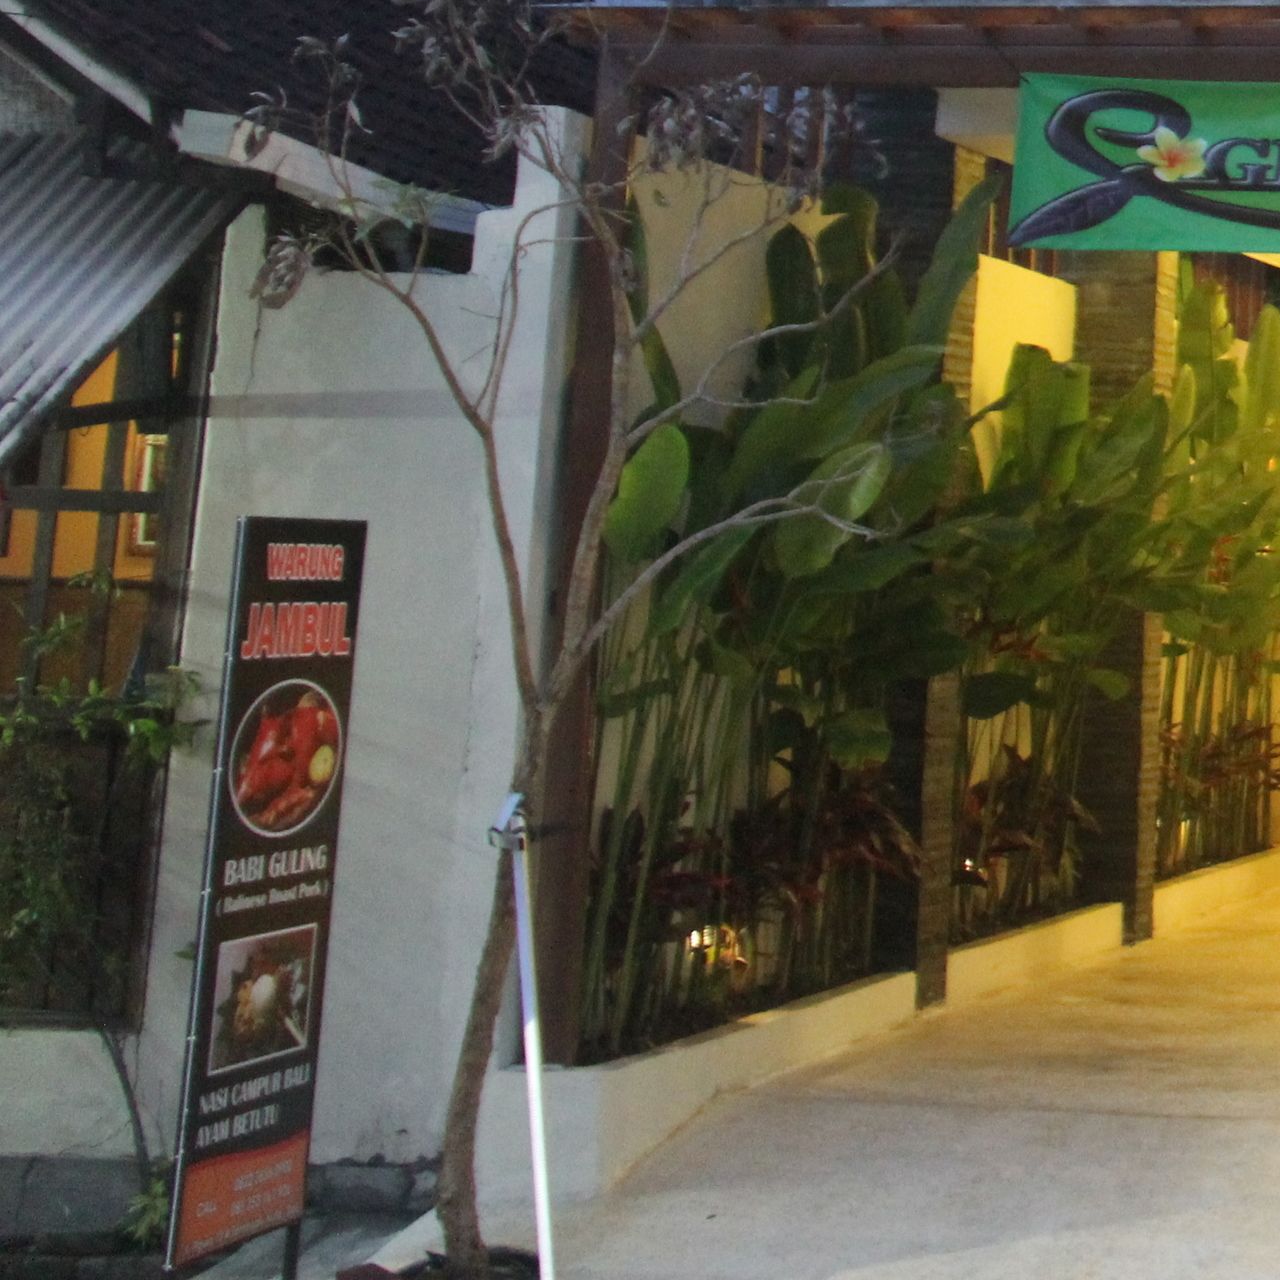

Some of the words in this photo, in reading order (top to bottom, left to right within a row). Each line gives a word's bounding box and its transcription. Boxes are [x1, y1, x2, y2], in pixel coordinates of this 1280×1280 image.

[267, 542, 345, 580] WARUNG
[240, 601, 351, 659] JAMBUL
[224, 854, 265, 886] BABI
[268, 844, 328, 878] GULING
[199, 1087, 229, 1115] NASI
[231, 1071, 282, 1106] CAMPUR
[284, 1062, 310, 1090] BALI
[195, 1118, 231, 1149] AYAM
